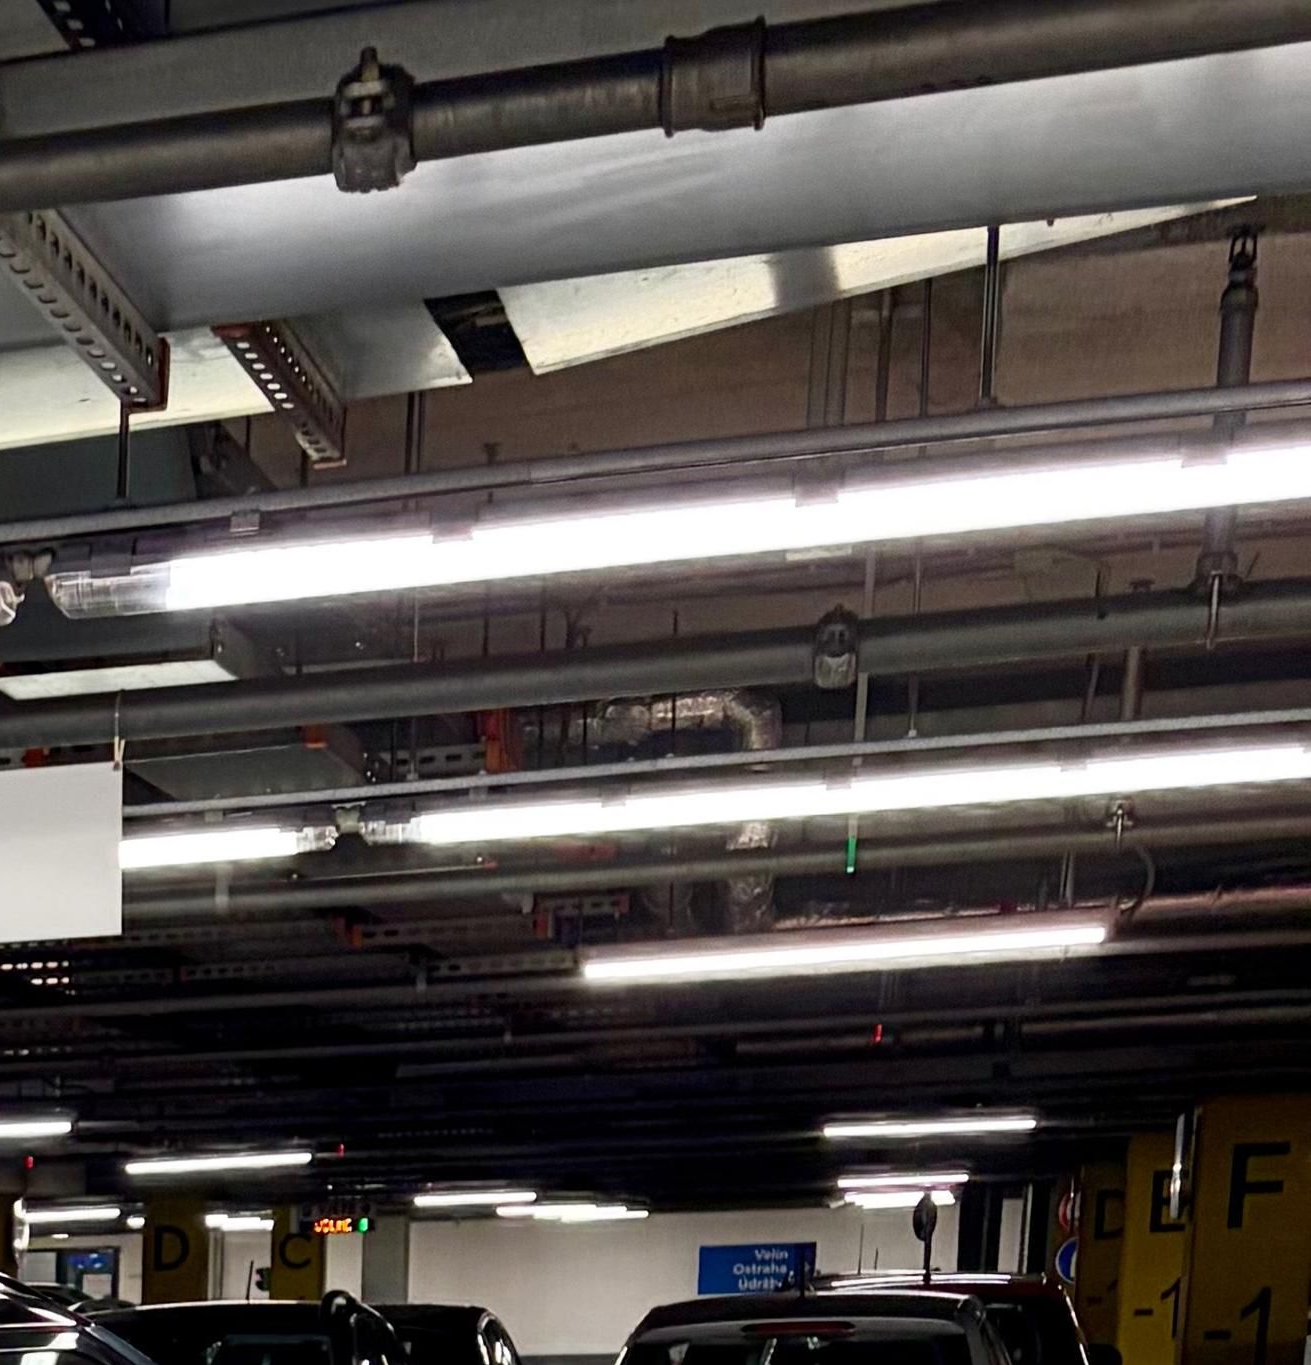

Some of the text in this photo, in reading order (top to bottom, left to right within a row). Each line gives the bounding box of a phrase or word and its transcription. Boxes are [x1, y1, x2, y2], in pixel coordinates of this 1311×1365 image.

[1227, 1141, 1291, 1229] F
[154, 1226, 190, 1271] D
[279, 1232, 312, 1270] C
